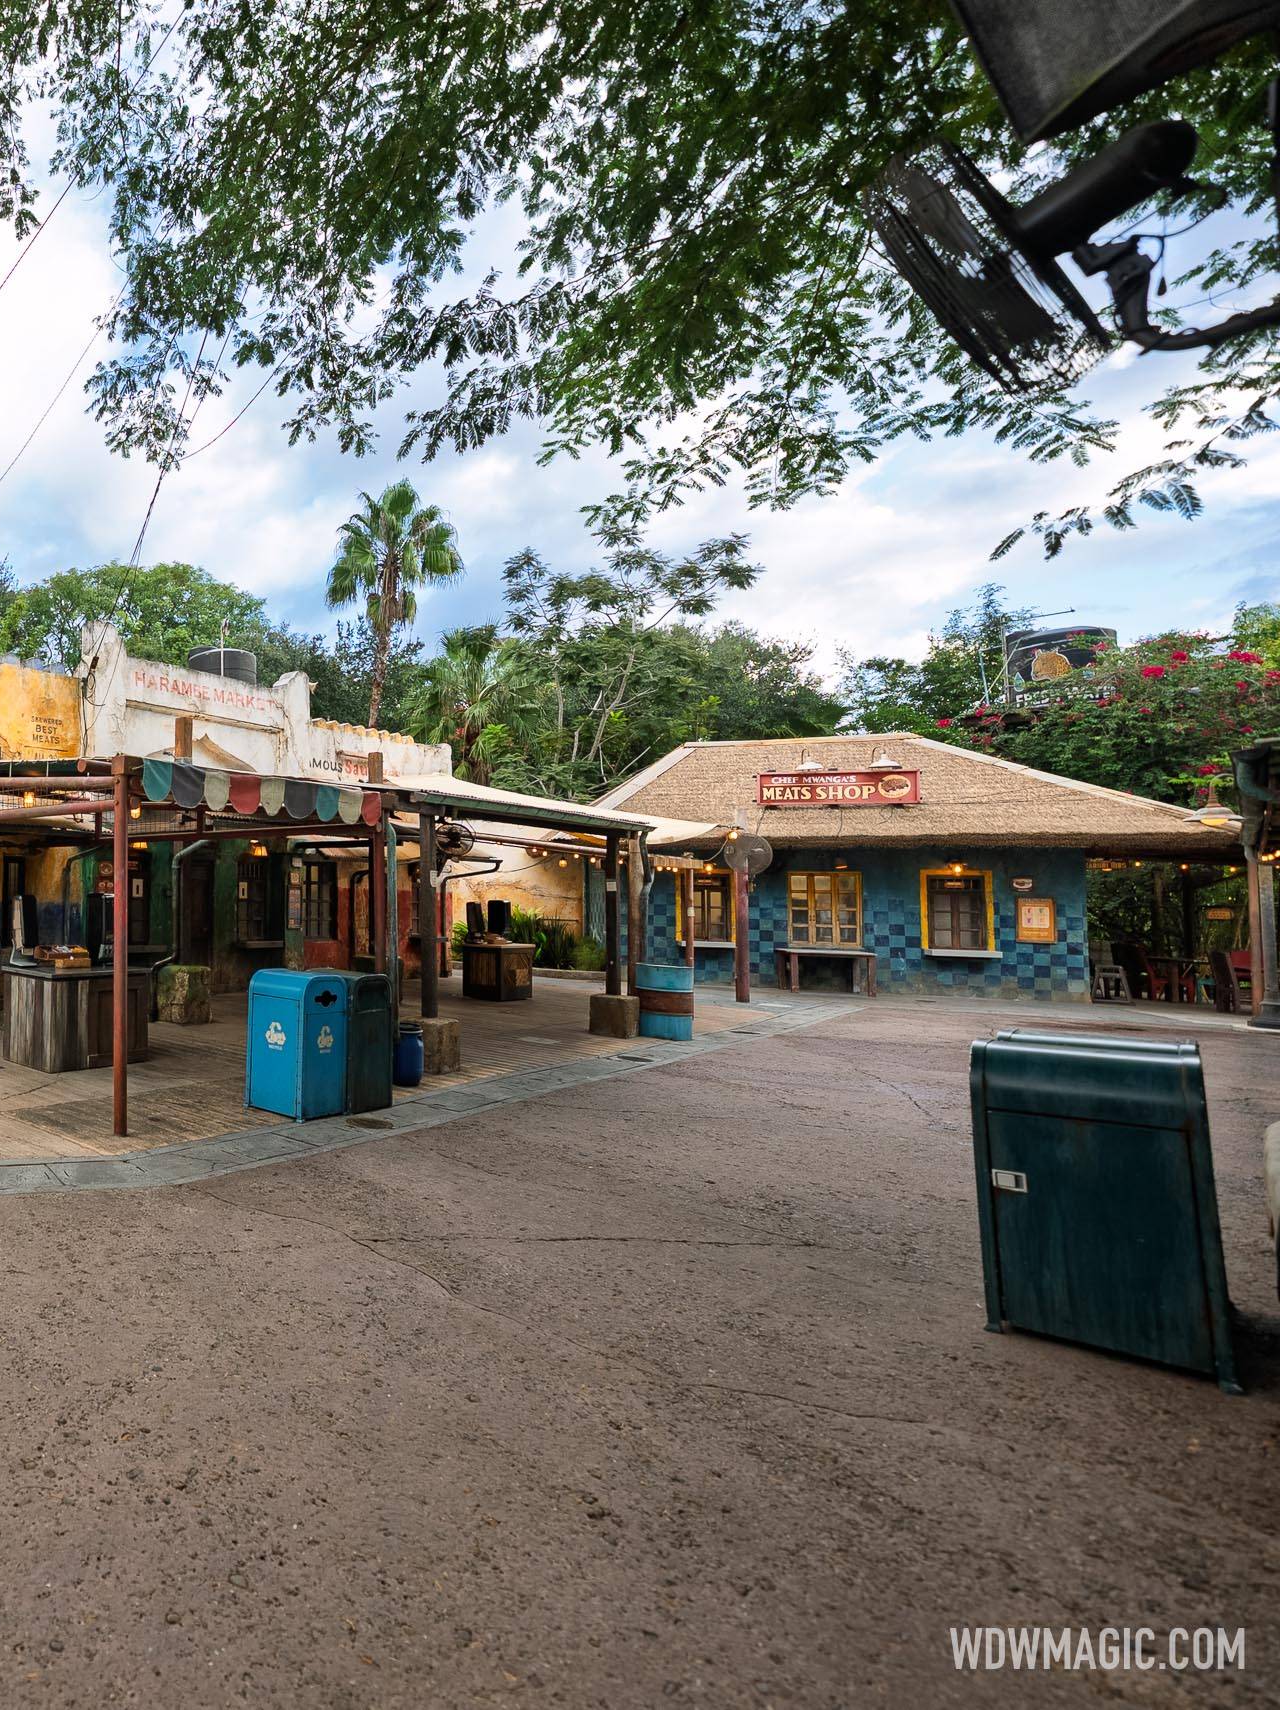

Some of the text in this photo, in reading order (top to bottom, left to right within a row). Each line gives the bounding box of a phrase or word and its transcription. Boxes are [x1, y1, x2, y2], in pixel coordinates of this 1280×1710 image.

[134, 671, 276, 712] HARAMBE MARKET
[35, 724, 58, 735] BEST
[32, 734, 60, 744] MEATS
[771, 775, 857, 784] CHEF MWANGA'S
[762, 785, 876, 800] MEATS SHOP
